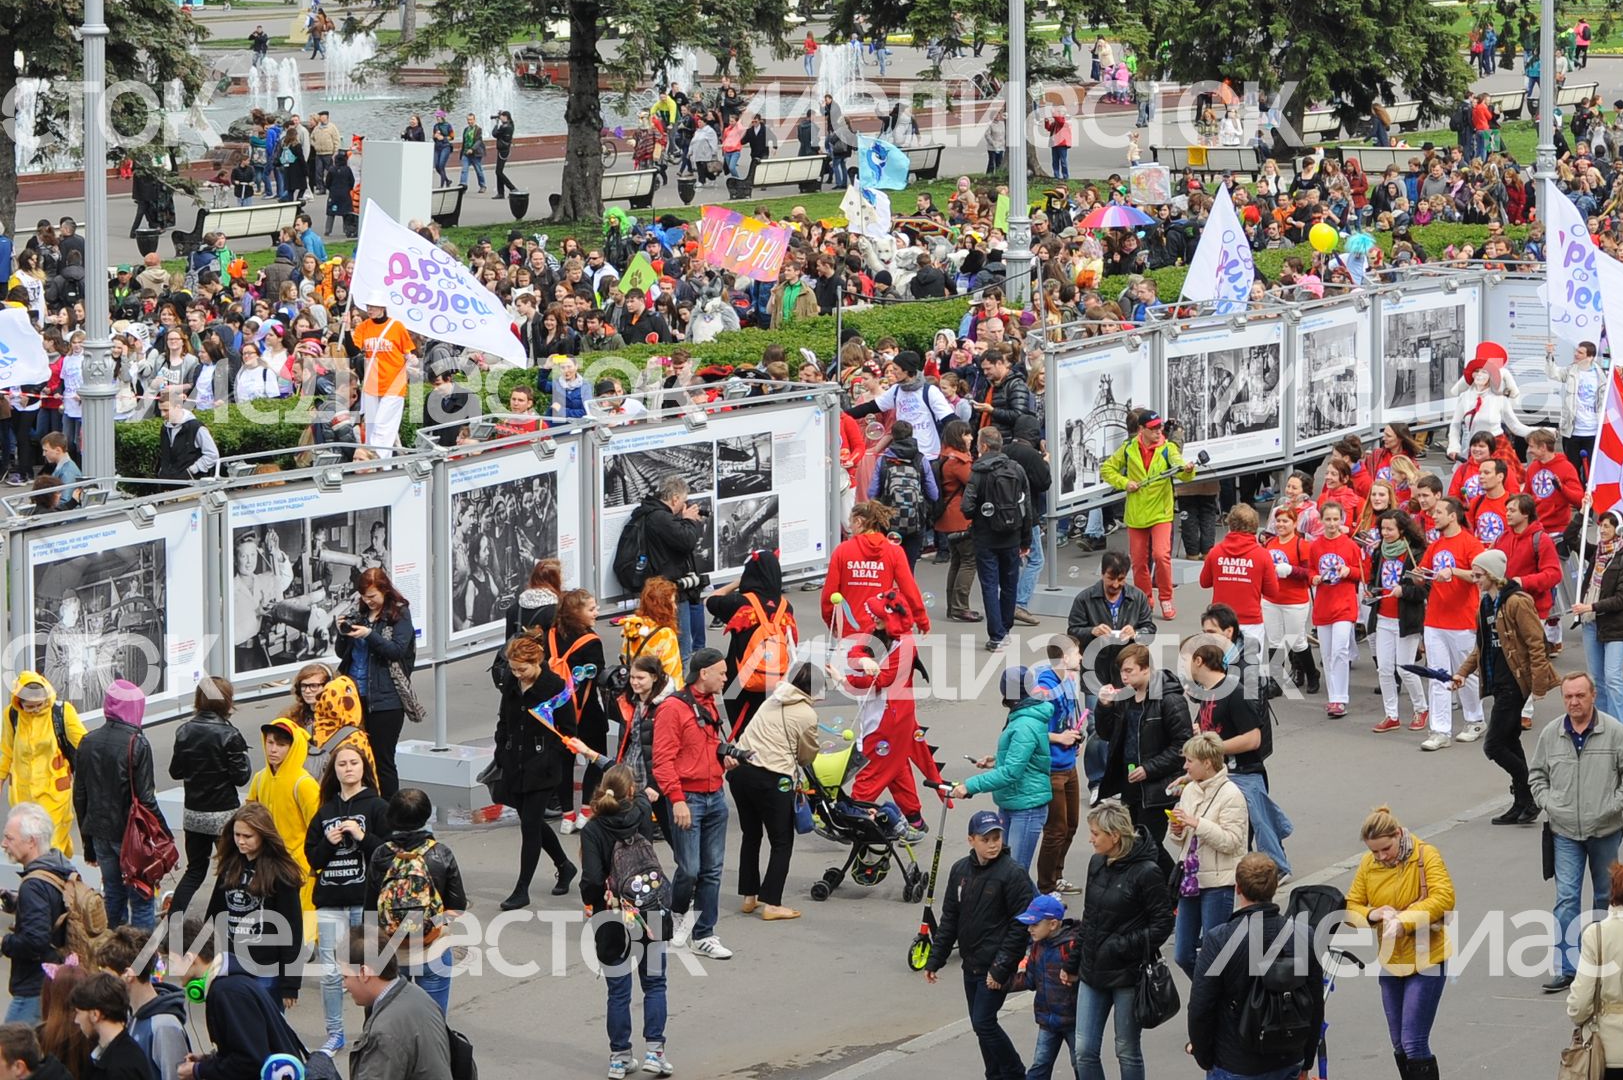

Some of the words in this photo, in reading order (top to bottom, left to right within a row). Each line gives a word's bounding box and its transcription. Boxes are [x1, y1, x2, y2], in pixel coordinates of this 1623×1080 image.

[847, 561, 884, 570] SAMBA
[1217, 557, 1253, 568] SAMBA
[852, 569, 879, 579] REAL
[1222, 565, 1248, 576] REAL
[325, 868, 360, 877] WHISKEY
